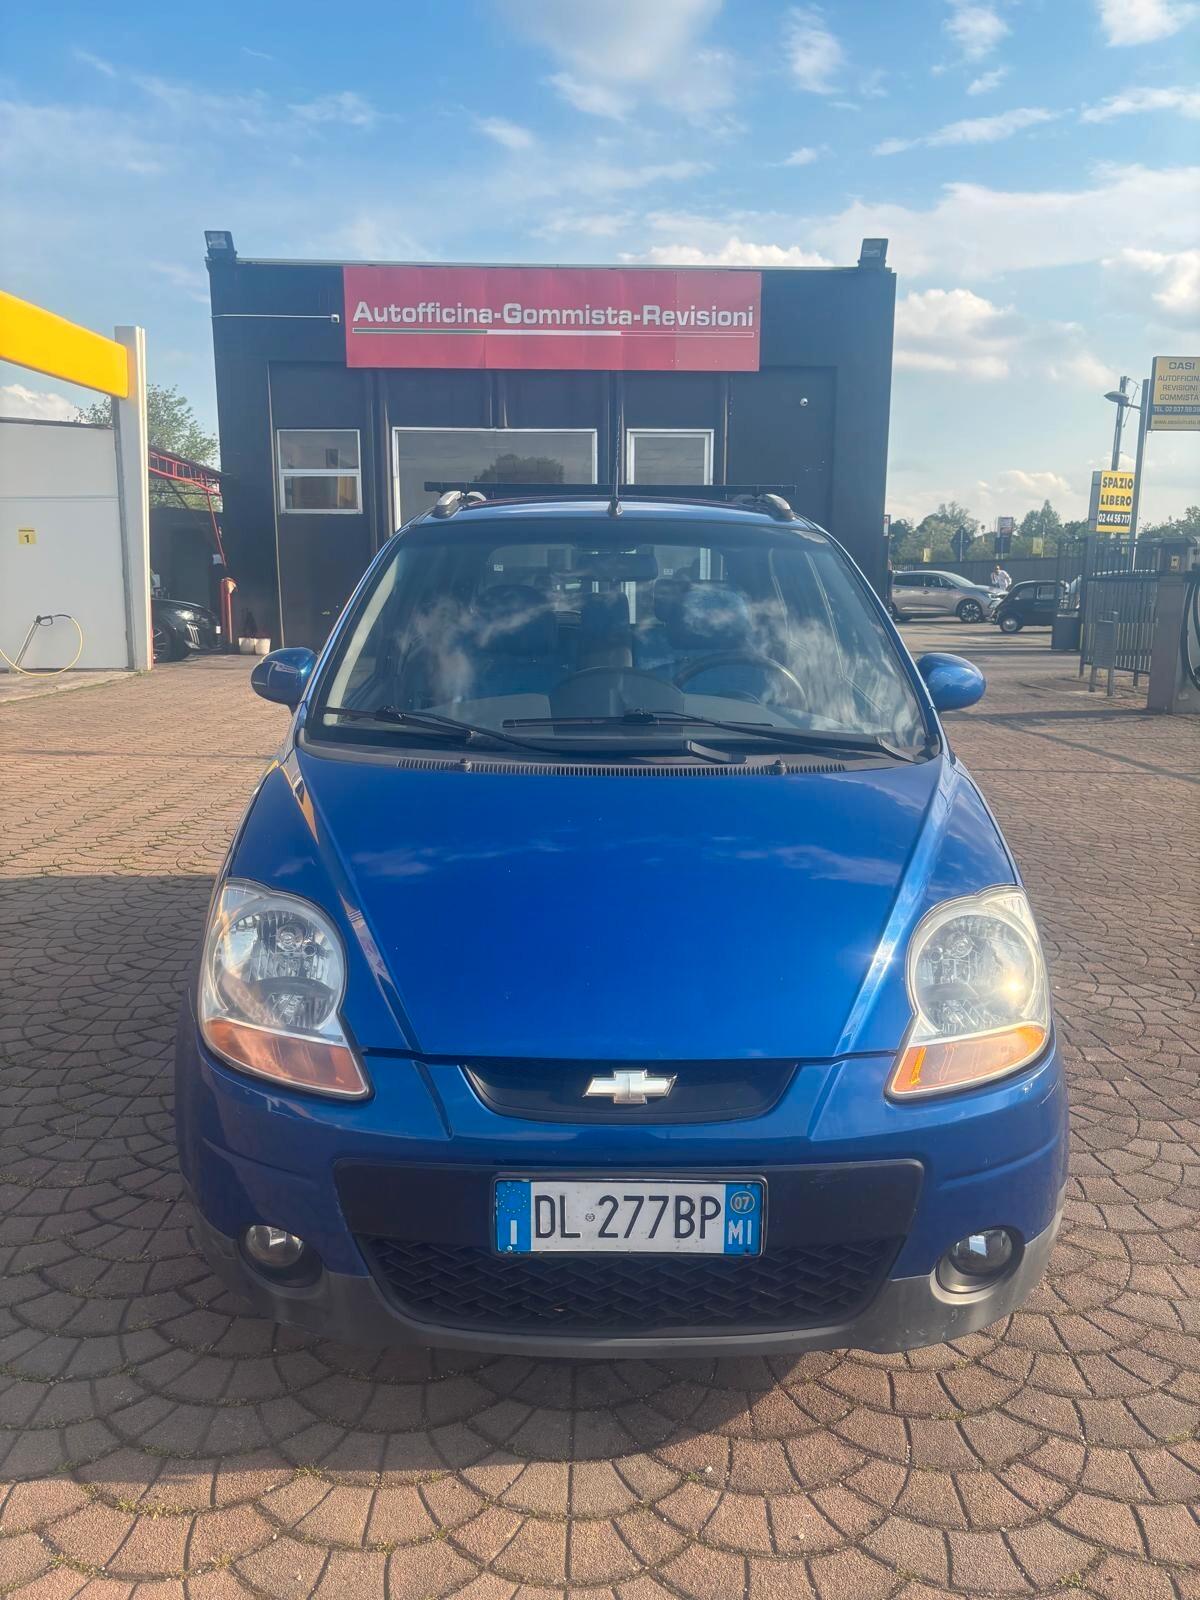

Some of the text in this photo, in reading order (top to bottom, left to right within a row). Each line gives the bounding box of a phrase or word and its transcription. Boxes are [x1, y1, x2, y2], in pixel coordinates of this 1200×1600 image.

[352, 301, 754, 327] Autofficina-Gommista-Revisioni
[1159, 393, 1199, 401] GOMMISTA
[1102, 476, 1134, 490] SPAZIO
[1100, 494, 1132, 506] LIBERO
[24, 534, 30, 544] 1
[733, 1196, 750, 1211] 07
[534, 1194, 722, 1239] DL 277BP
[727, 1219, 753, 1245] MI
